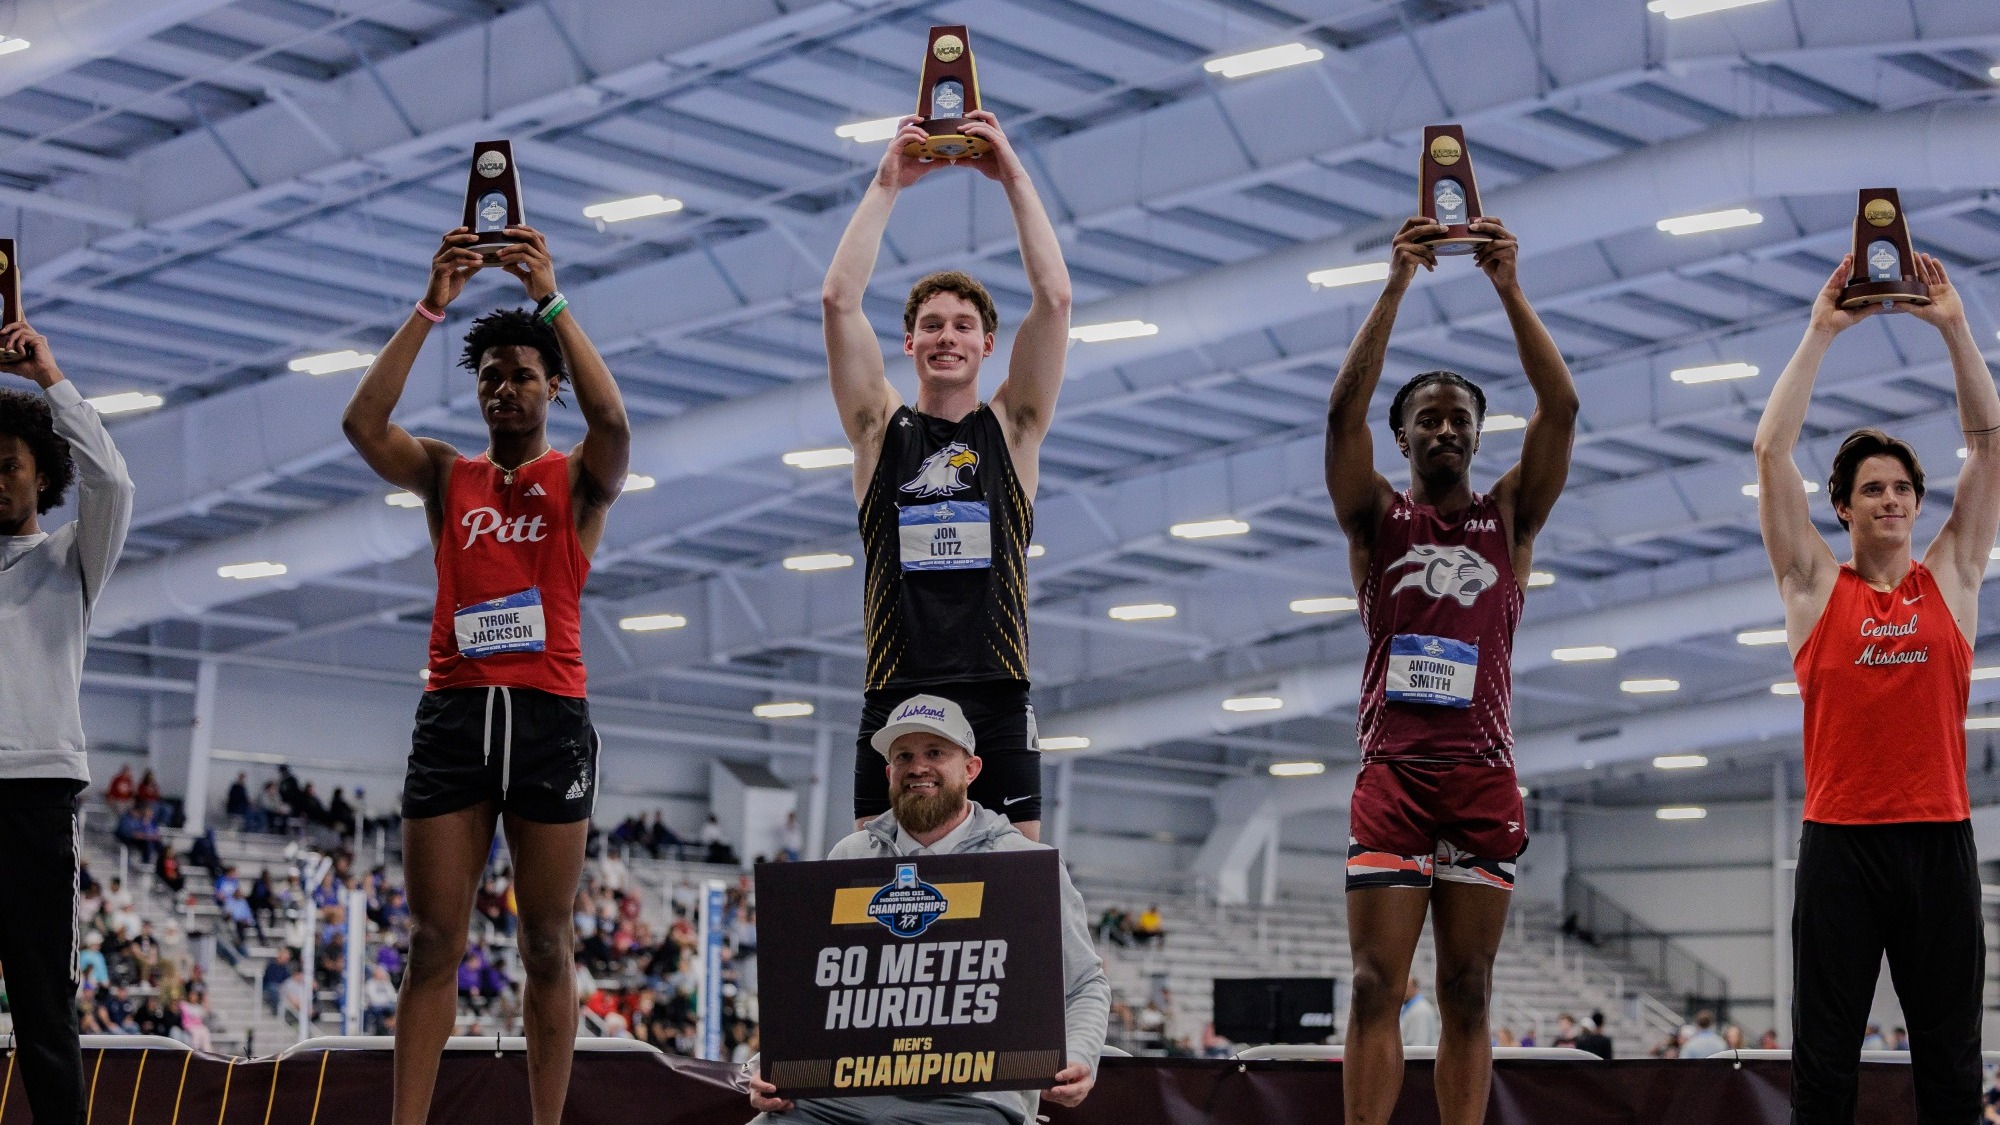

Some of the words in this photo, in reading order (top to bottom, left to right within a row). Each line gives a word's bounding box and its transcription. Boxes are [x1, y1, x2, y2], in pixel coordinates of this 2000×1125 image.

[936, 46, 961, 55] NCAA
[479, 163, 504, 171] NCAA
[462, 507, 547, 550] Pitt
[934, 527, 957, 539] JON
[930, 541, 961, 556] LUTZ
[478, 612, 520, 628] TYRONE
[1861, 613, 1918, 637] Central
[470, 625, 533, 644] JACKSON
[1855, 643, 1928, 665] Missouri
[1408, 660, 1455, 676] ANTONIO
[1409, 674, 1451, 691] SMITH
[897, 705, 945, 721] Ashland
[566, 791, 584, 799] adidas
[869, 901, 947, 915] CHAMPIONSHIPS
[815, 945, 868, 986] 60
[878, 939, 1008, 984] METER
[825, 983, 1000, 1030] HURDLES
[892, 1037, 933, 1052] MEN'S
[833, 1051, 995, 1088] CHAMPION
